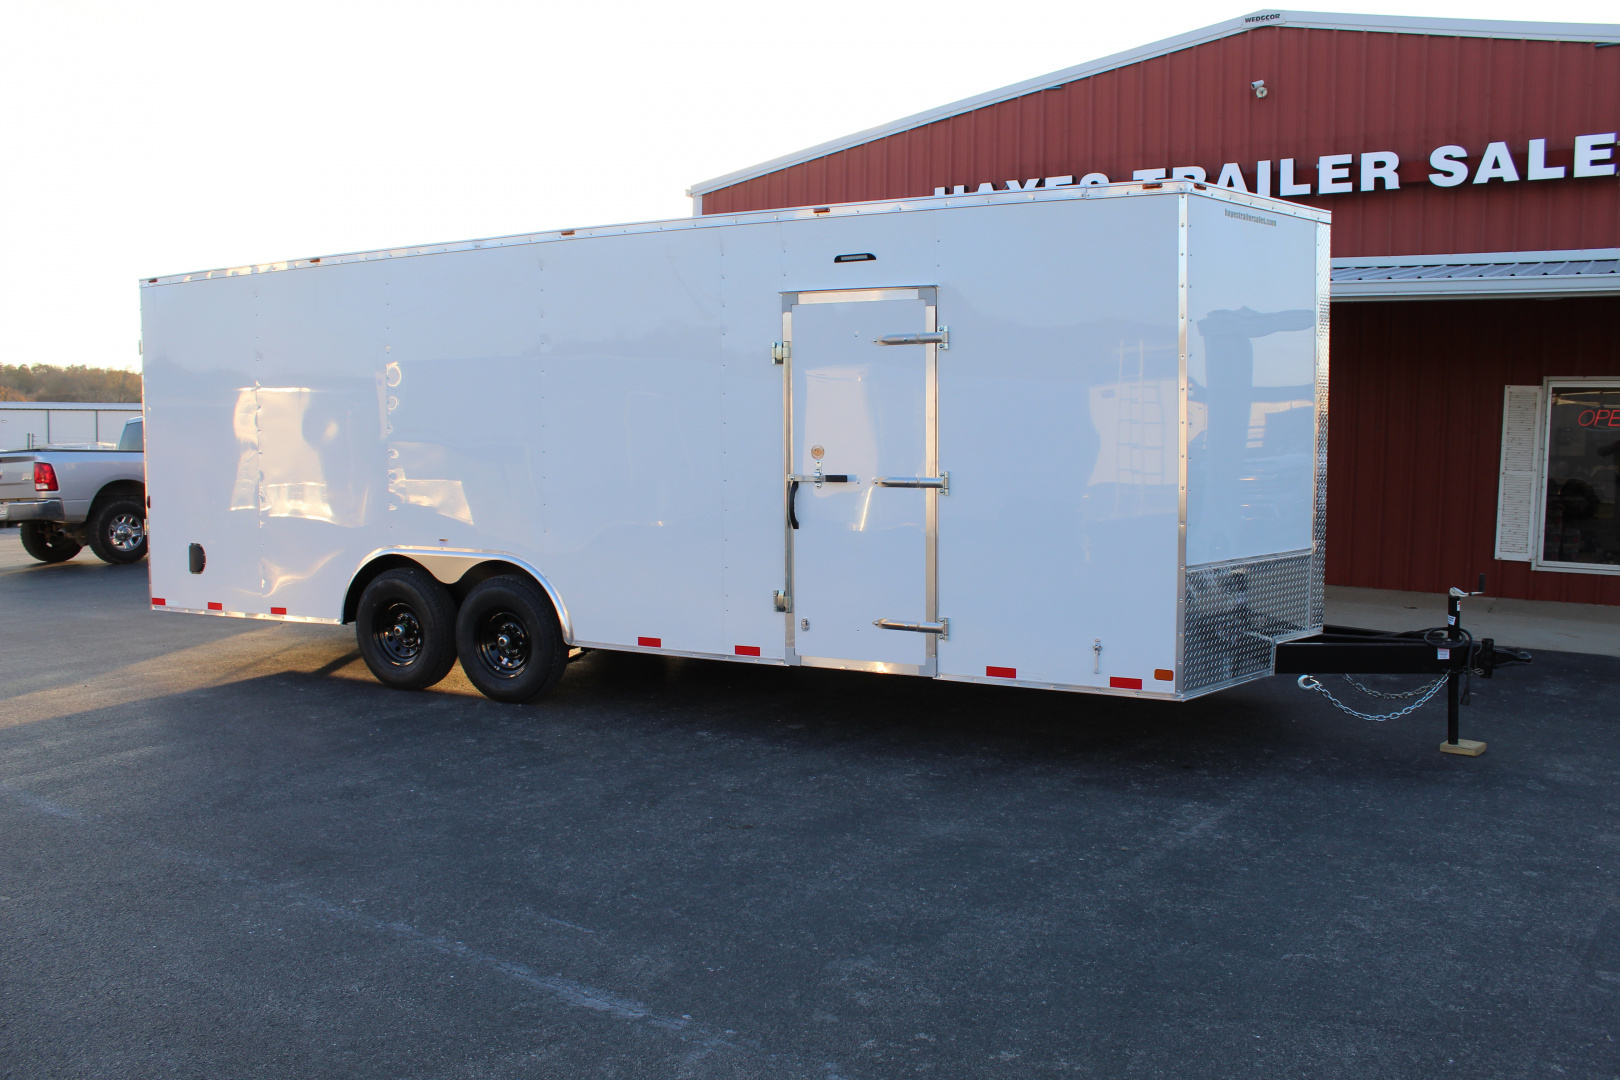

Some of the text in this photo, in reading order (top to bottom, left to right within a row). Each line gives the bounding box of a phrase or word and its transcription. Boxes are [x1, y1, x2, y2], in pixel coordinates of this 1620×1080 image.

[1244, 13, 1281, 23] WEDGCOR
[1224, 208, 1277, 226] hayestrailersales.com
[1578, 409, 1620, 427] OPE
